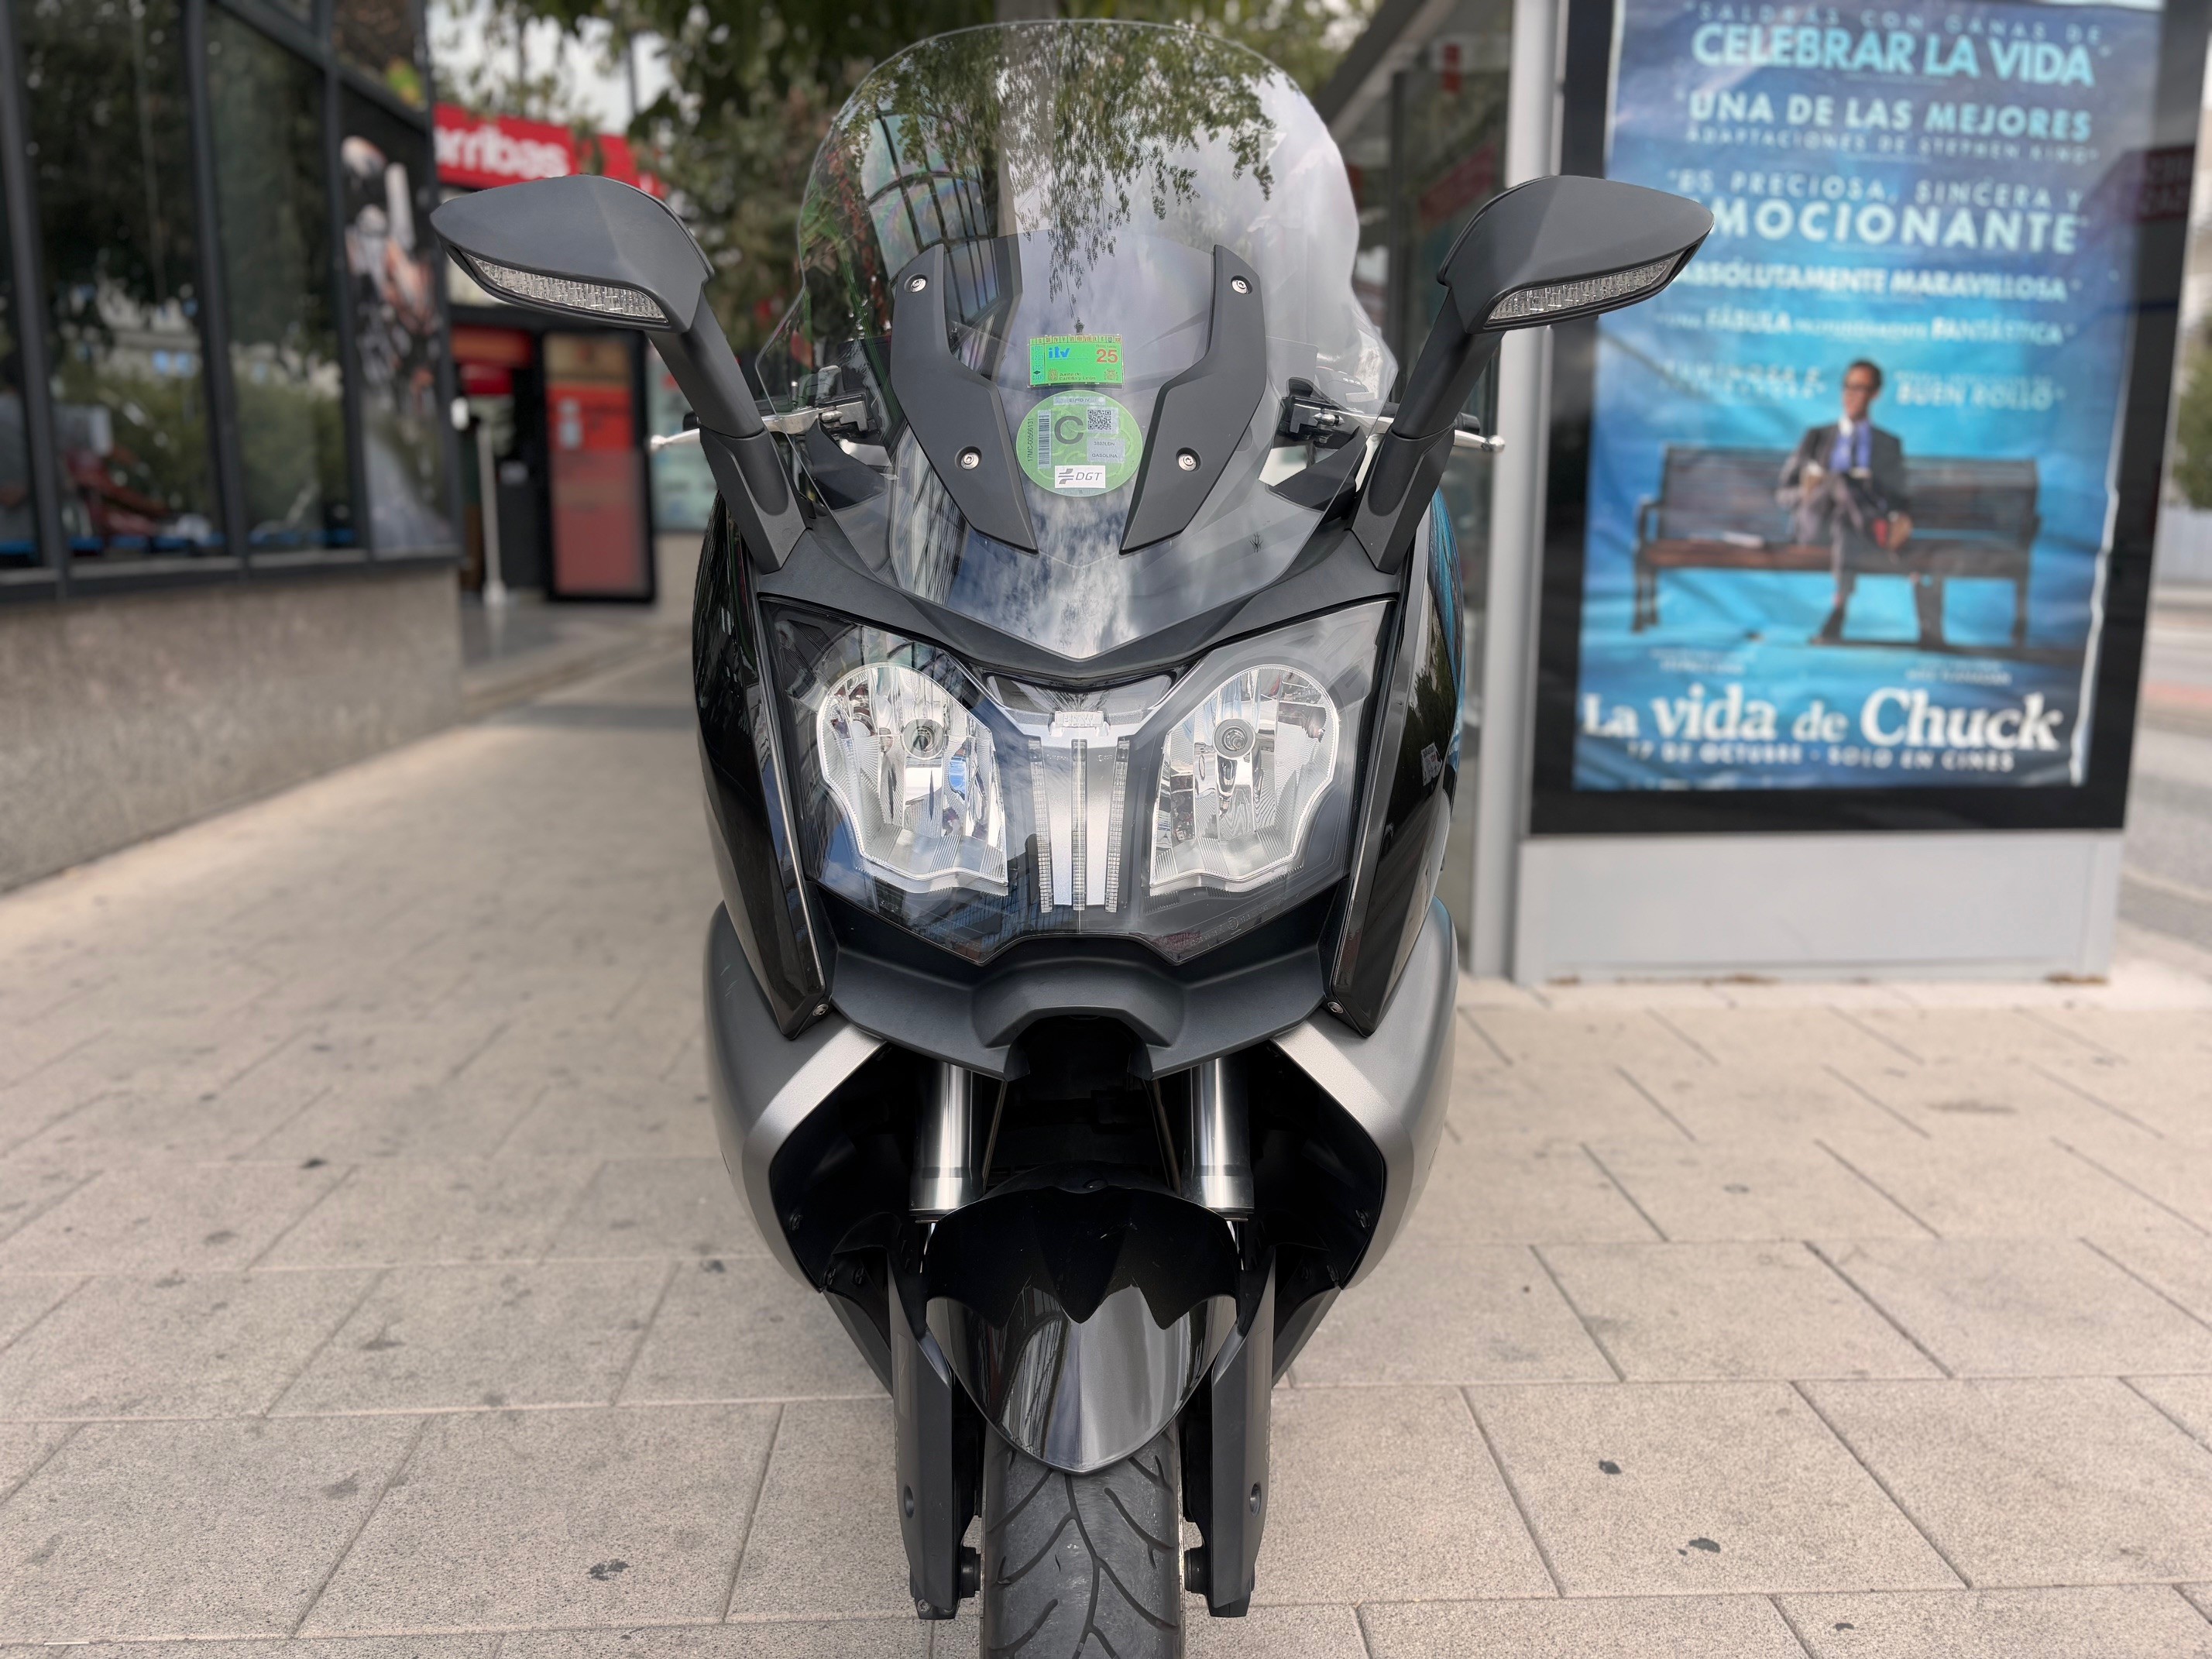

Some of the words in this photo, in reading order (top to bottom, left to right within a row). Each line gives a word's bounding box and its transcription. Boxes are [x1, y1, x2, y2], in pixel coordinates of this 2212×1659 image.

[1692, 22, 1915, 74] CELEBRAR
[1924, 33, 1981, 77] LA
[2066, 22, 2102, 46] DE
[1787, 93, 1834, 127] DE
[1844, 97, 1913, 131] LAS
[1925, 101, 2092, 142] MEJORES
[1915, 179, 2052, 209] SINCERA
[2066, 190, 2083, 211] Y
[1096, 349, 1118, 363] 25
[1054, 415, 1084, 445] C
[1076, 472, 1102, 481] DGT
[1582, 692, 1639, 738] La
[1650, 682, 1778, 741] vida
[1792, 699, 1849, 743] de
[1860, 687, 2064, 751] Chuck
[1661, 741, 1692, 764] DE
[1699, 742, 1802, 764] OCTUBRE
[1827, 745, 1894, 768] SOLO
[1900, 749, 1934, 770] EN
[1941, 750, 2014, 773] CINES
